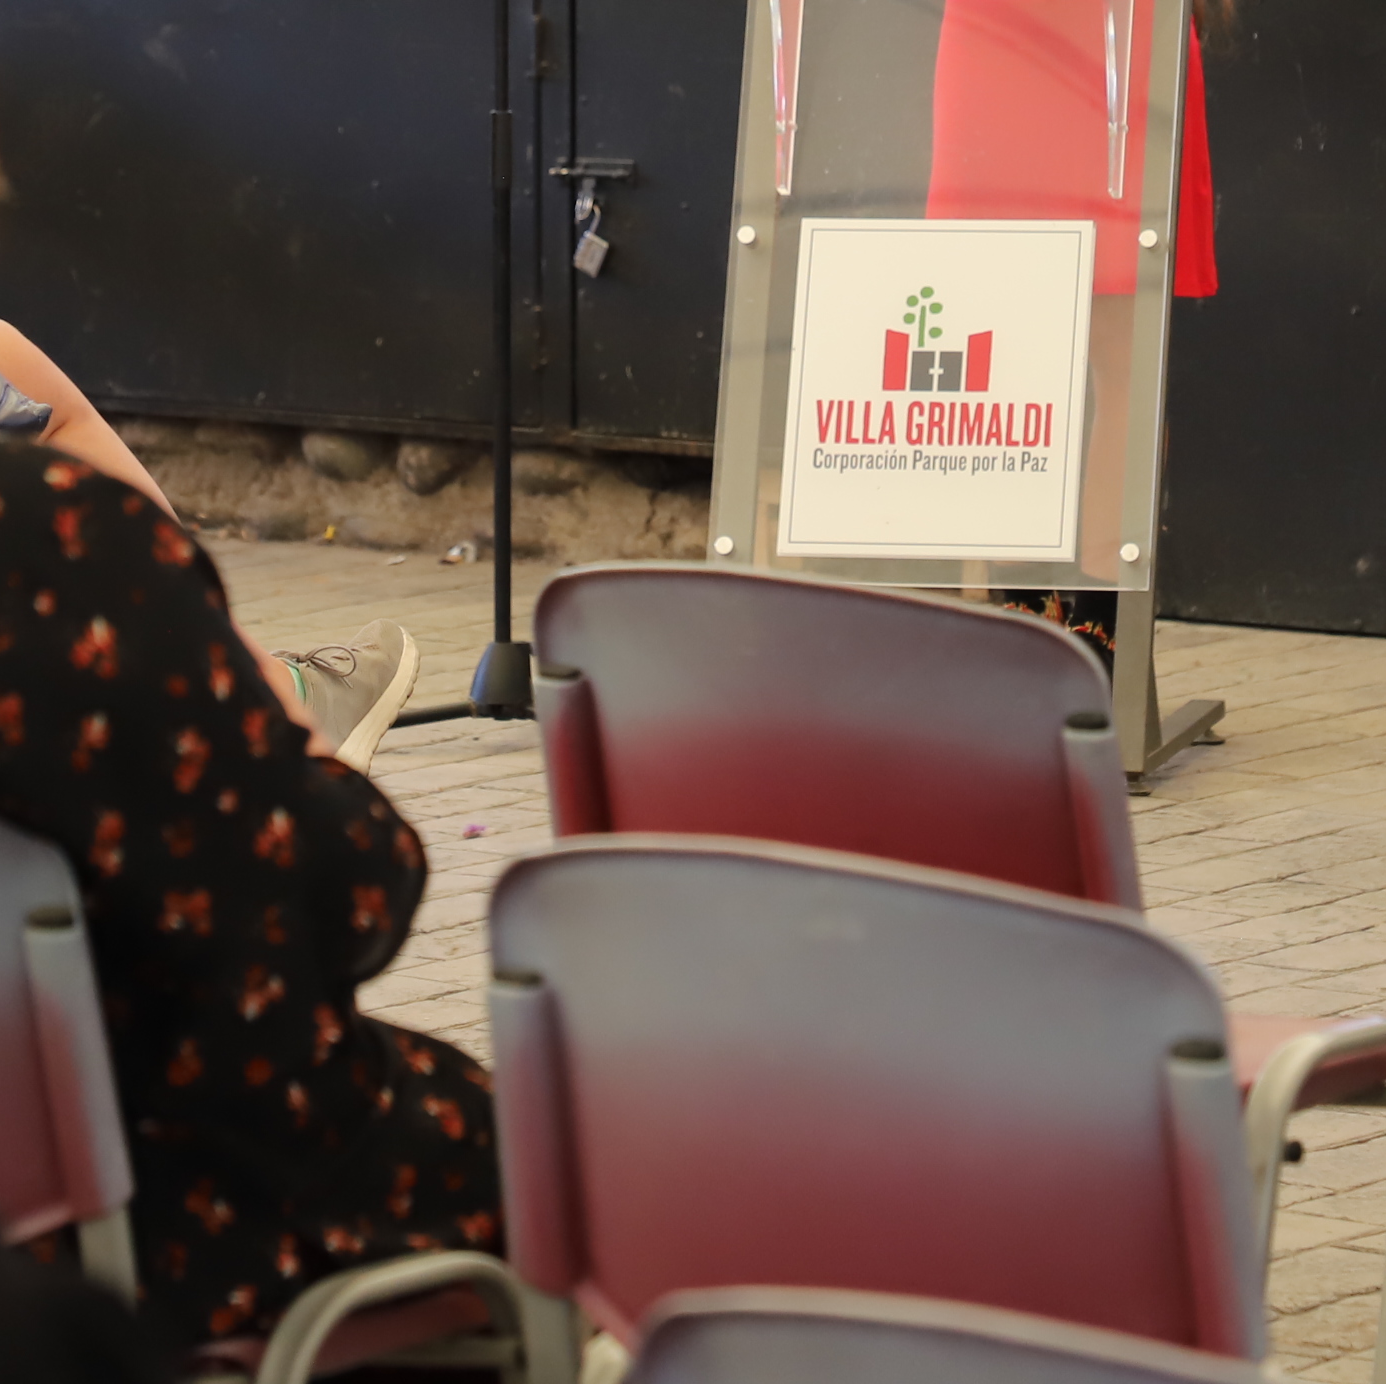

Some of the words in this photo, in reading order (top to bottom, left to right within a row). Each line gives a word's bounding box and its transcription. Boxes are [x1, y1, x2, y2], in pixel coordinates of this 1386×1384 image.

[816, 400, 896, 444] VILLA
[906, 401, 1053, 447] GRIMALDI
[813, 448, 907, 474] Corporación
[913, 449, 968, 476] Parque
[972, 455, 998, 476] por
[1002, 450, 1016, 472] la
[1021, 451, 1048, 472] Paz
